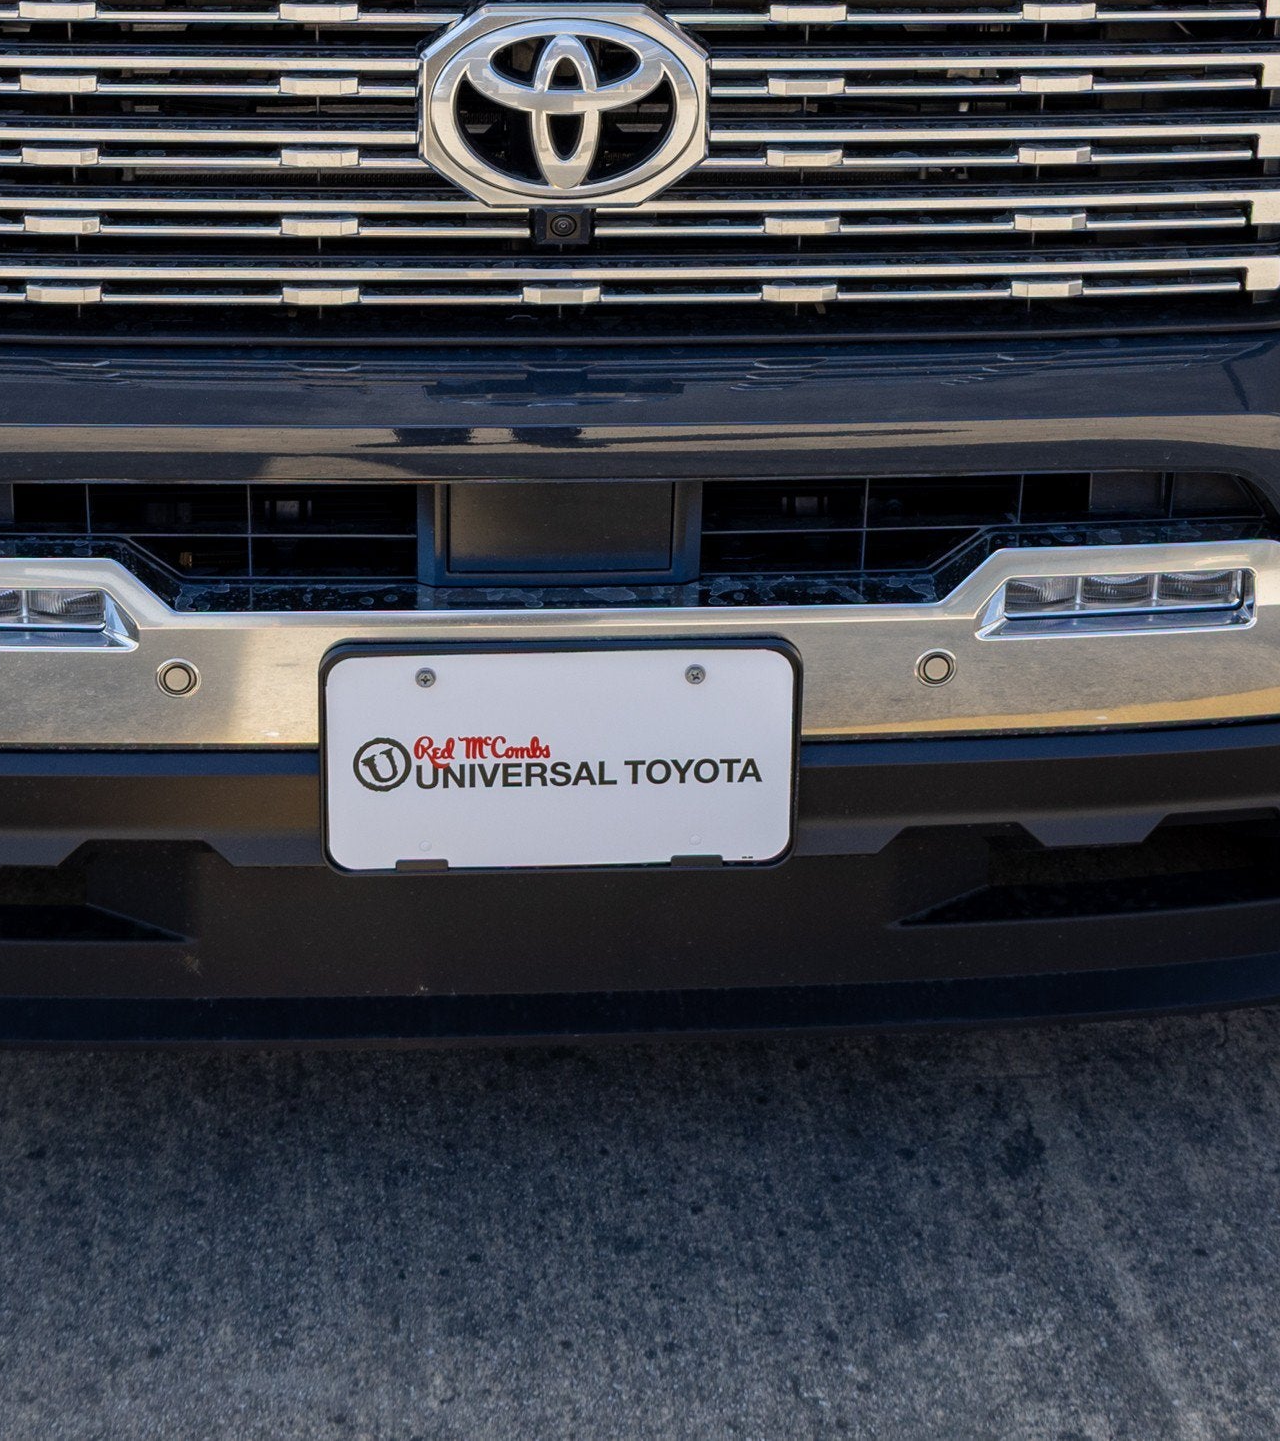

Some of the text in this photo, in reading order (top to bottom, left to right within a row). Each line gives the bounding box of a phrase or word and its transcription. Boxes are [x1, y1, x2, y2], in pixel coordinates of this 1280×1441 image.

[414, 735, 551, 769] Red McCombs
[416, 758, 762, 789] UNIVERSAL TOYOTA
